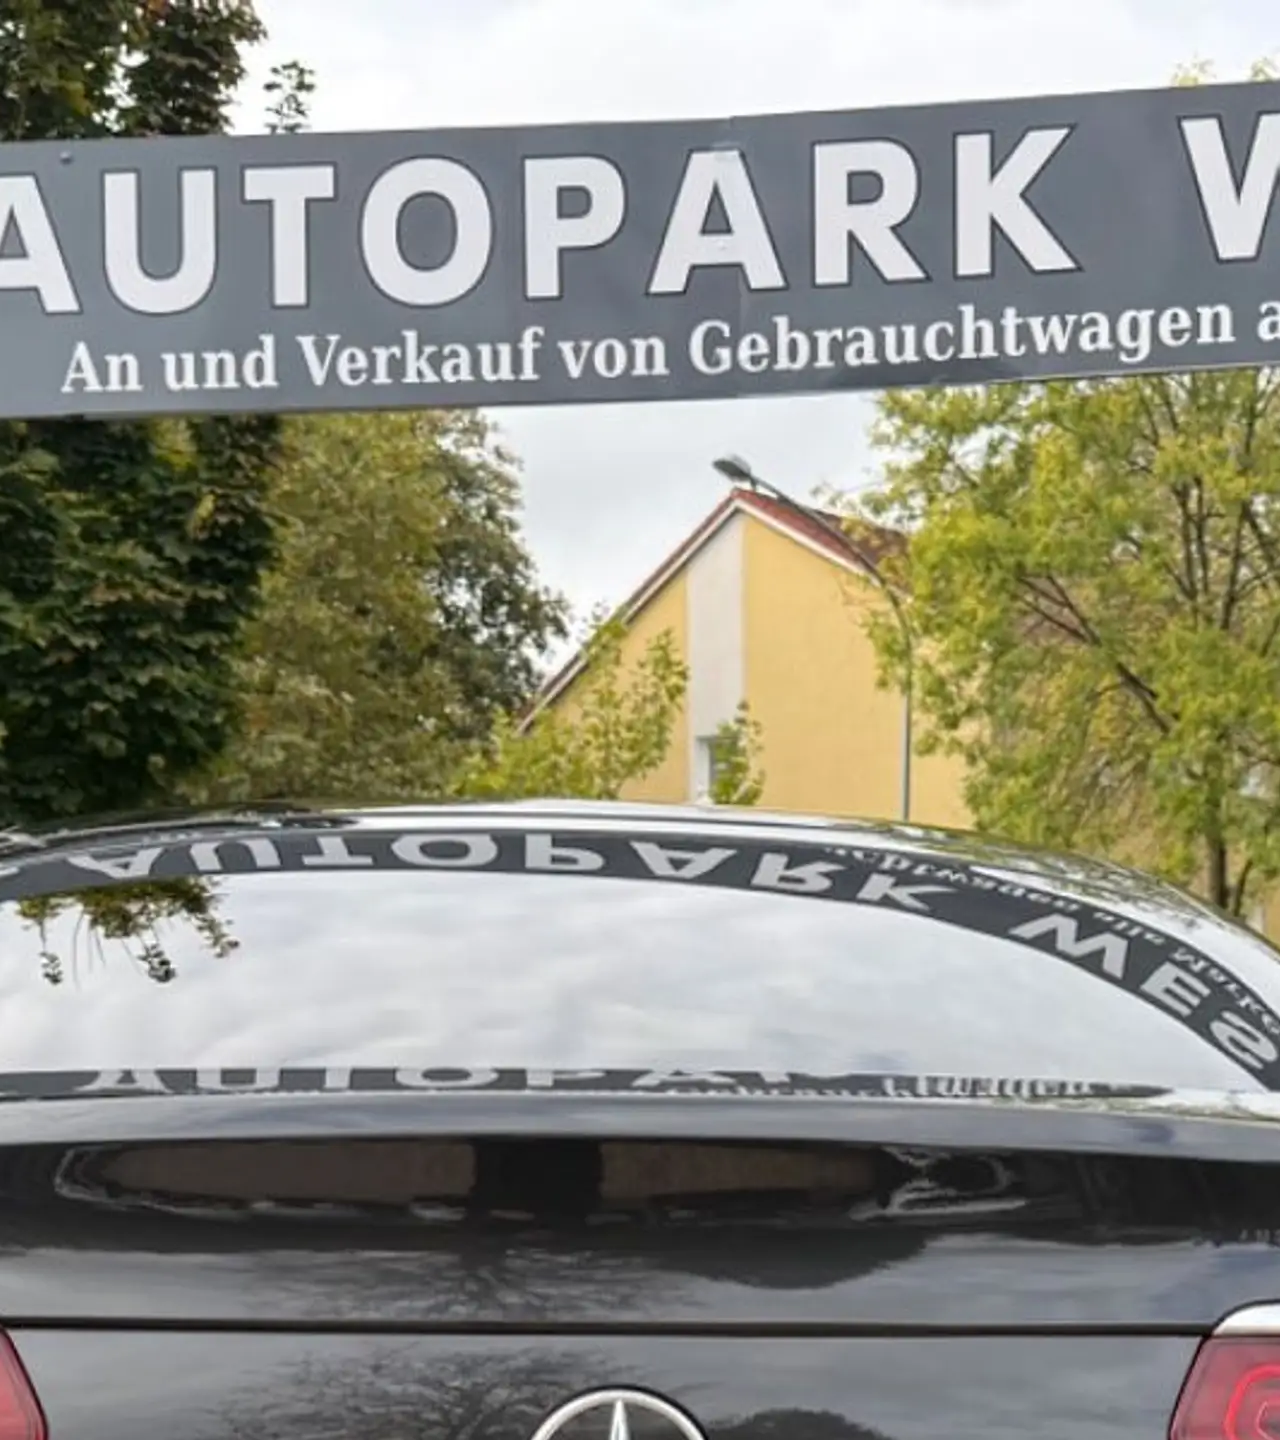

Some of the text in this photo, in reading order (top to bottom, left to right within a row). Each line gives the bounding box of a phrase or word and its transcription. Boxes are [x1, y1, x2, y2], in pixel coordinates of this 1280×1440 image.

[60, 341, 153, 395] An
[163, 337, 279, 391] und
[297, 328, 546, 386] Verkauf
[558, 336, 667, 379] von
[689, 302, 1235, 375] Gebrauchtwagen
